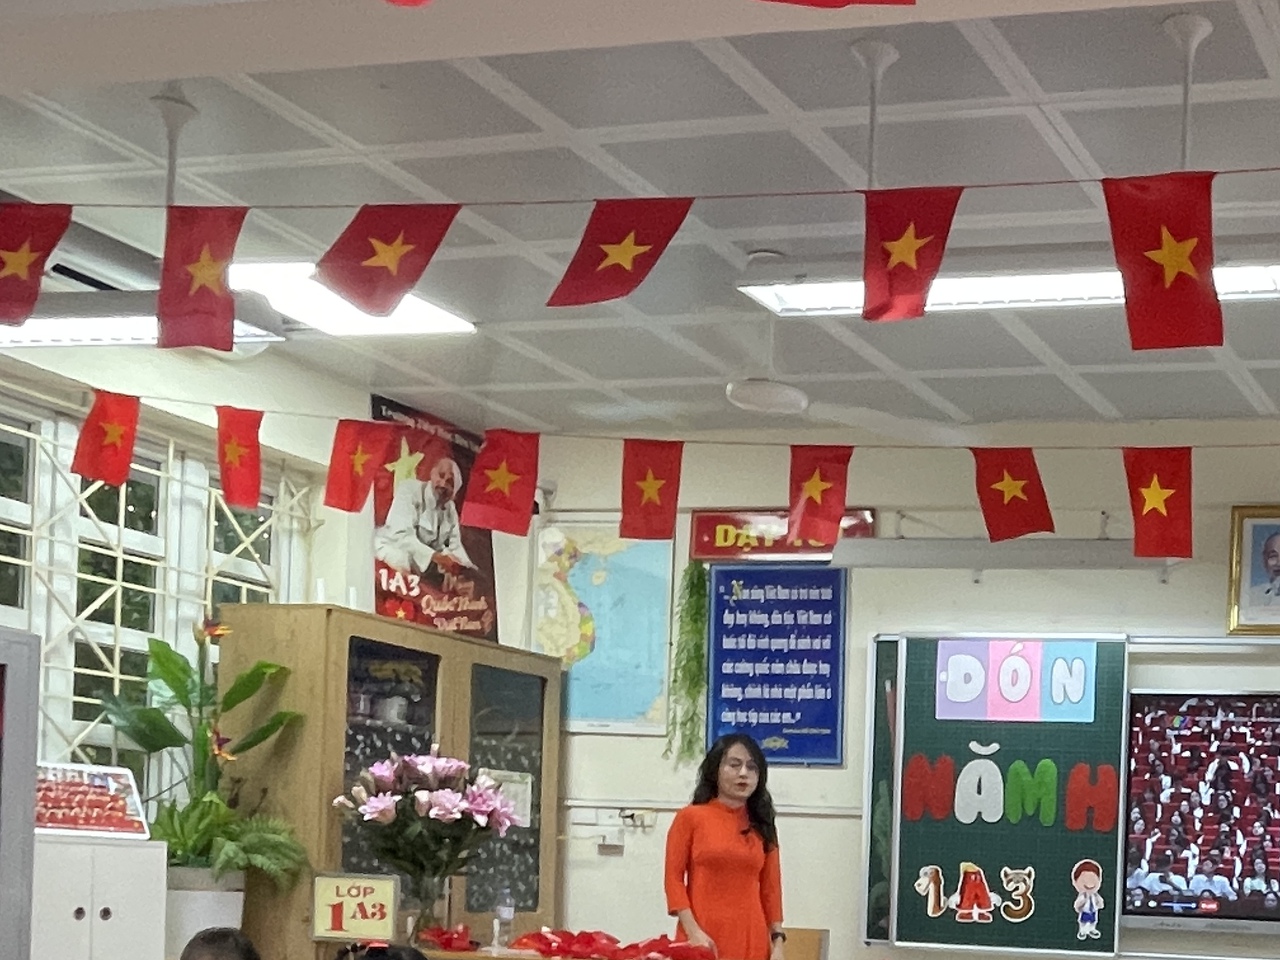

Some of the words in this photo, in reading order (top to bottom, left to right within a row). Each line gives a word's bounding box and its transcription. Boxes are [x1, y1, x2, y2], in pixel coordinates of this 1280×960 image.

[379, 568, 420, 597] 1A3
[939, 643, 1086, 705] ĐÓN
[902, 741, 1058, 827] NĂM
[335, 882, 376, 898] LỚP
